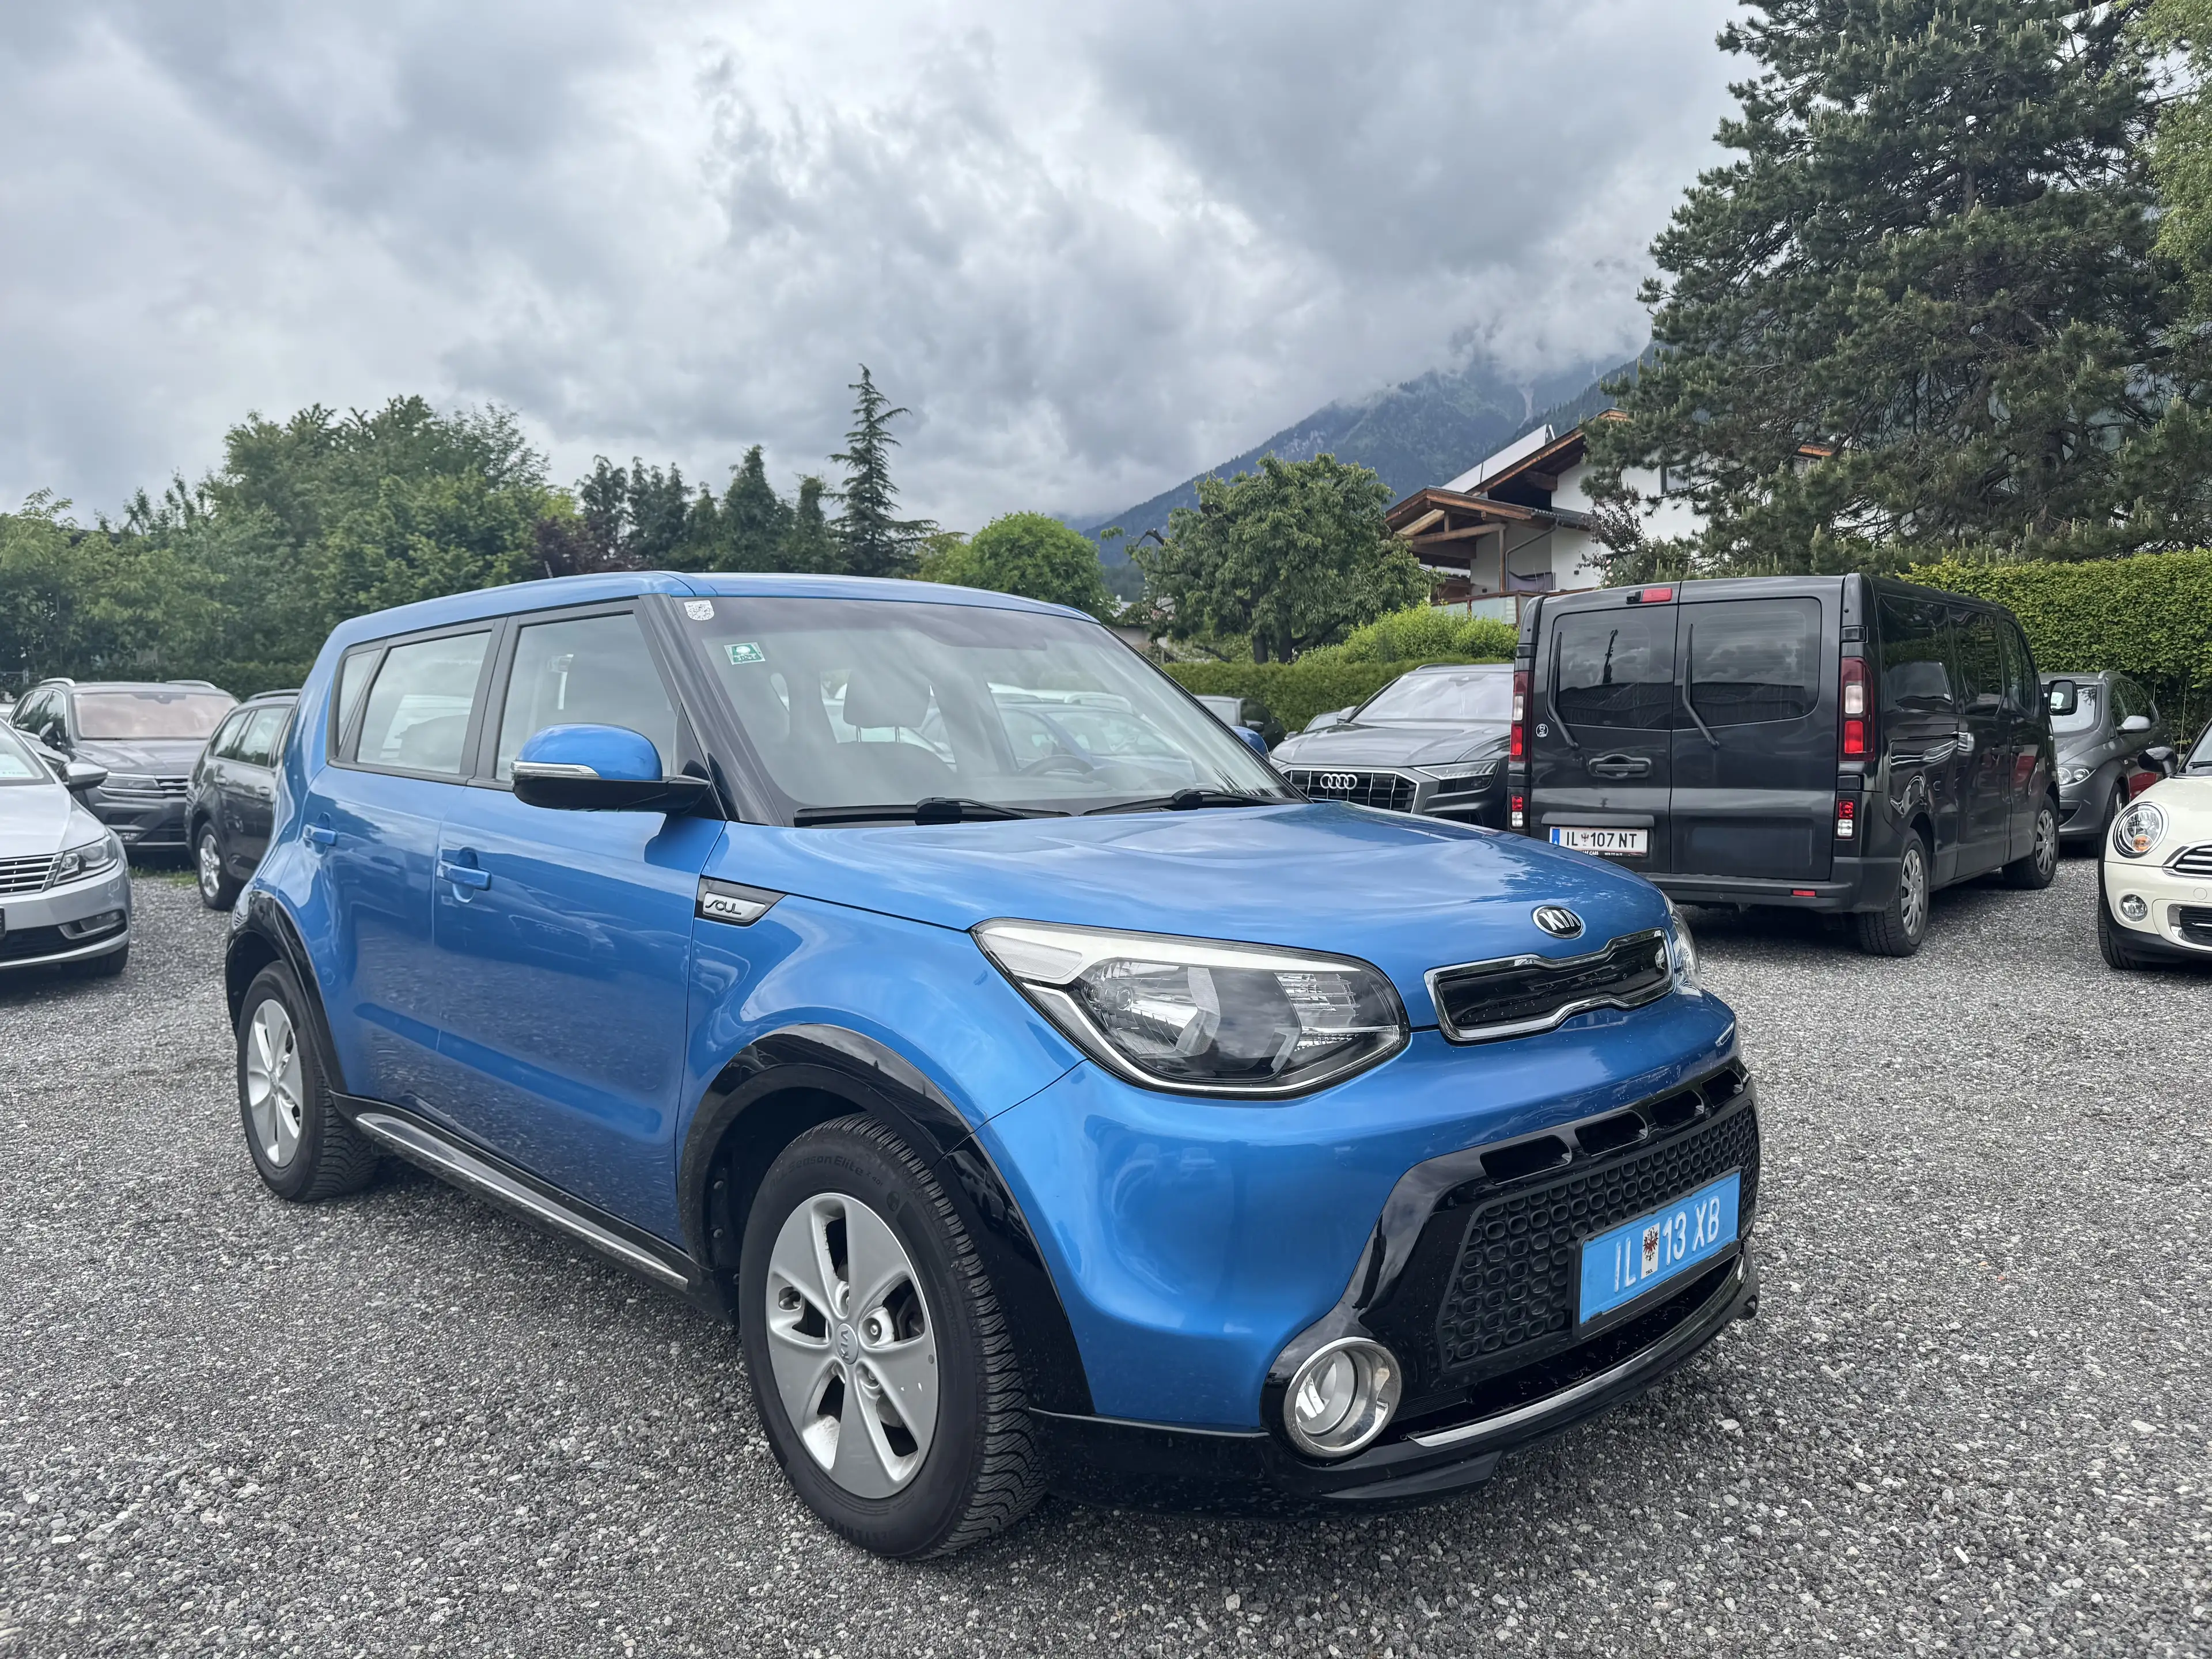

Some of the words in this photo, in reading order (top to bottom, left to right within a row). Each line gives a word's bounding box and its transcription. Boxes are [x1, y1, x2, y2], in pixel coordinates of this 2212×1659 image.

[1567, 832, 1578, 846] IL
[1590, 832, 1615, 848] 107
[1619, 833, 1637, 849] NT
[704, 899, 742, 915] SOUL
[1539, 909, 1581, 931] KIA
[834, 1156, 864, 1177] Elite
[1615, 1236, 1637, 1293] IL
[1662, 1211, 1687, 1266] 13
[1691, 1195, 1720, 1252] XB
[840, 1329, 850, 1361] KIA
